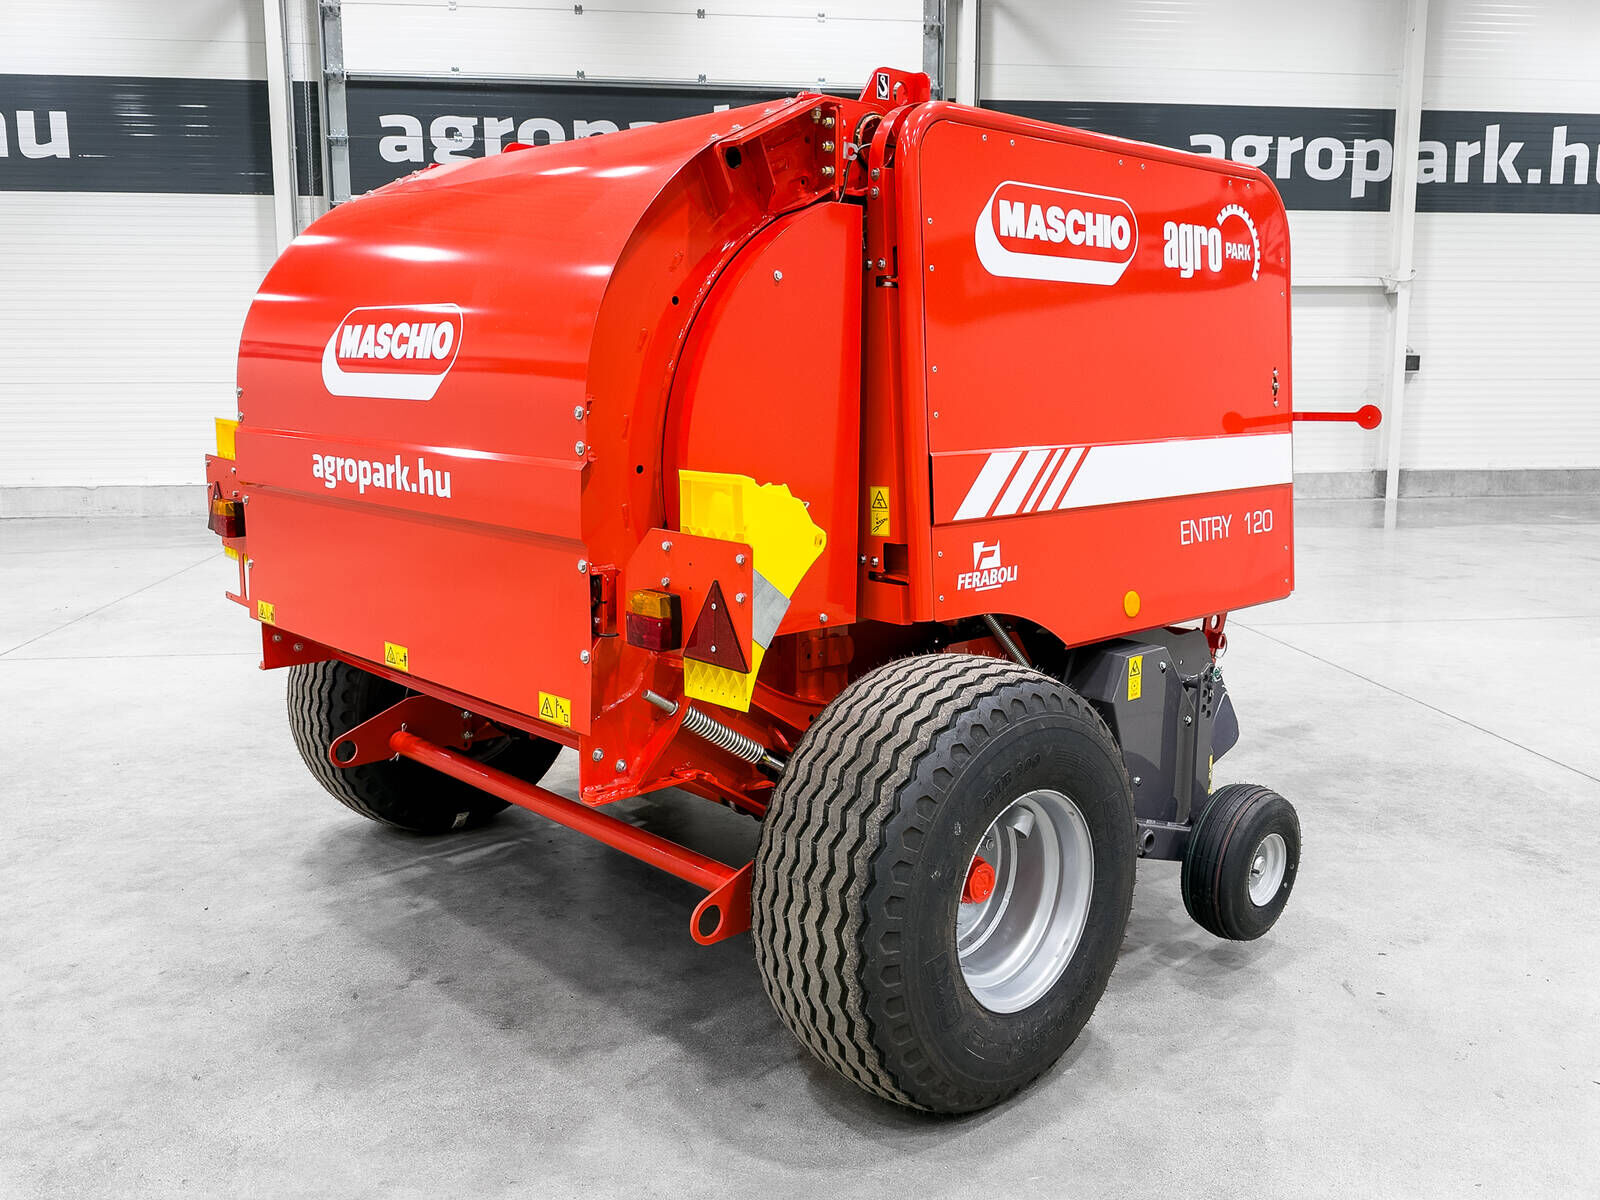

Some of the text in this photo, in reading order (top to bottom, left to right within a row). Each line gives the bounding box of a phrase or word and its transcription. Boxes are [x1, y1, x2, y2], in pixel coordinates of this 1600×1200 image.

[0, 110, 70, 158] u
[1189, 124, 1600, 199] gropark.h
[999, 199, 1131, 251] MASCHIO
[1163, 221, 1223, 279] agro
[1225, 241, 1251, 261] PARK
[338, 321, 454, 360] MASCHIO
[312, 453, 452, 498] agropark.hu
[1180, 509, 1273, 546] ENTRY 120
[957, 564, 1018, 590] FERABOLI
